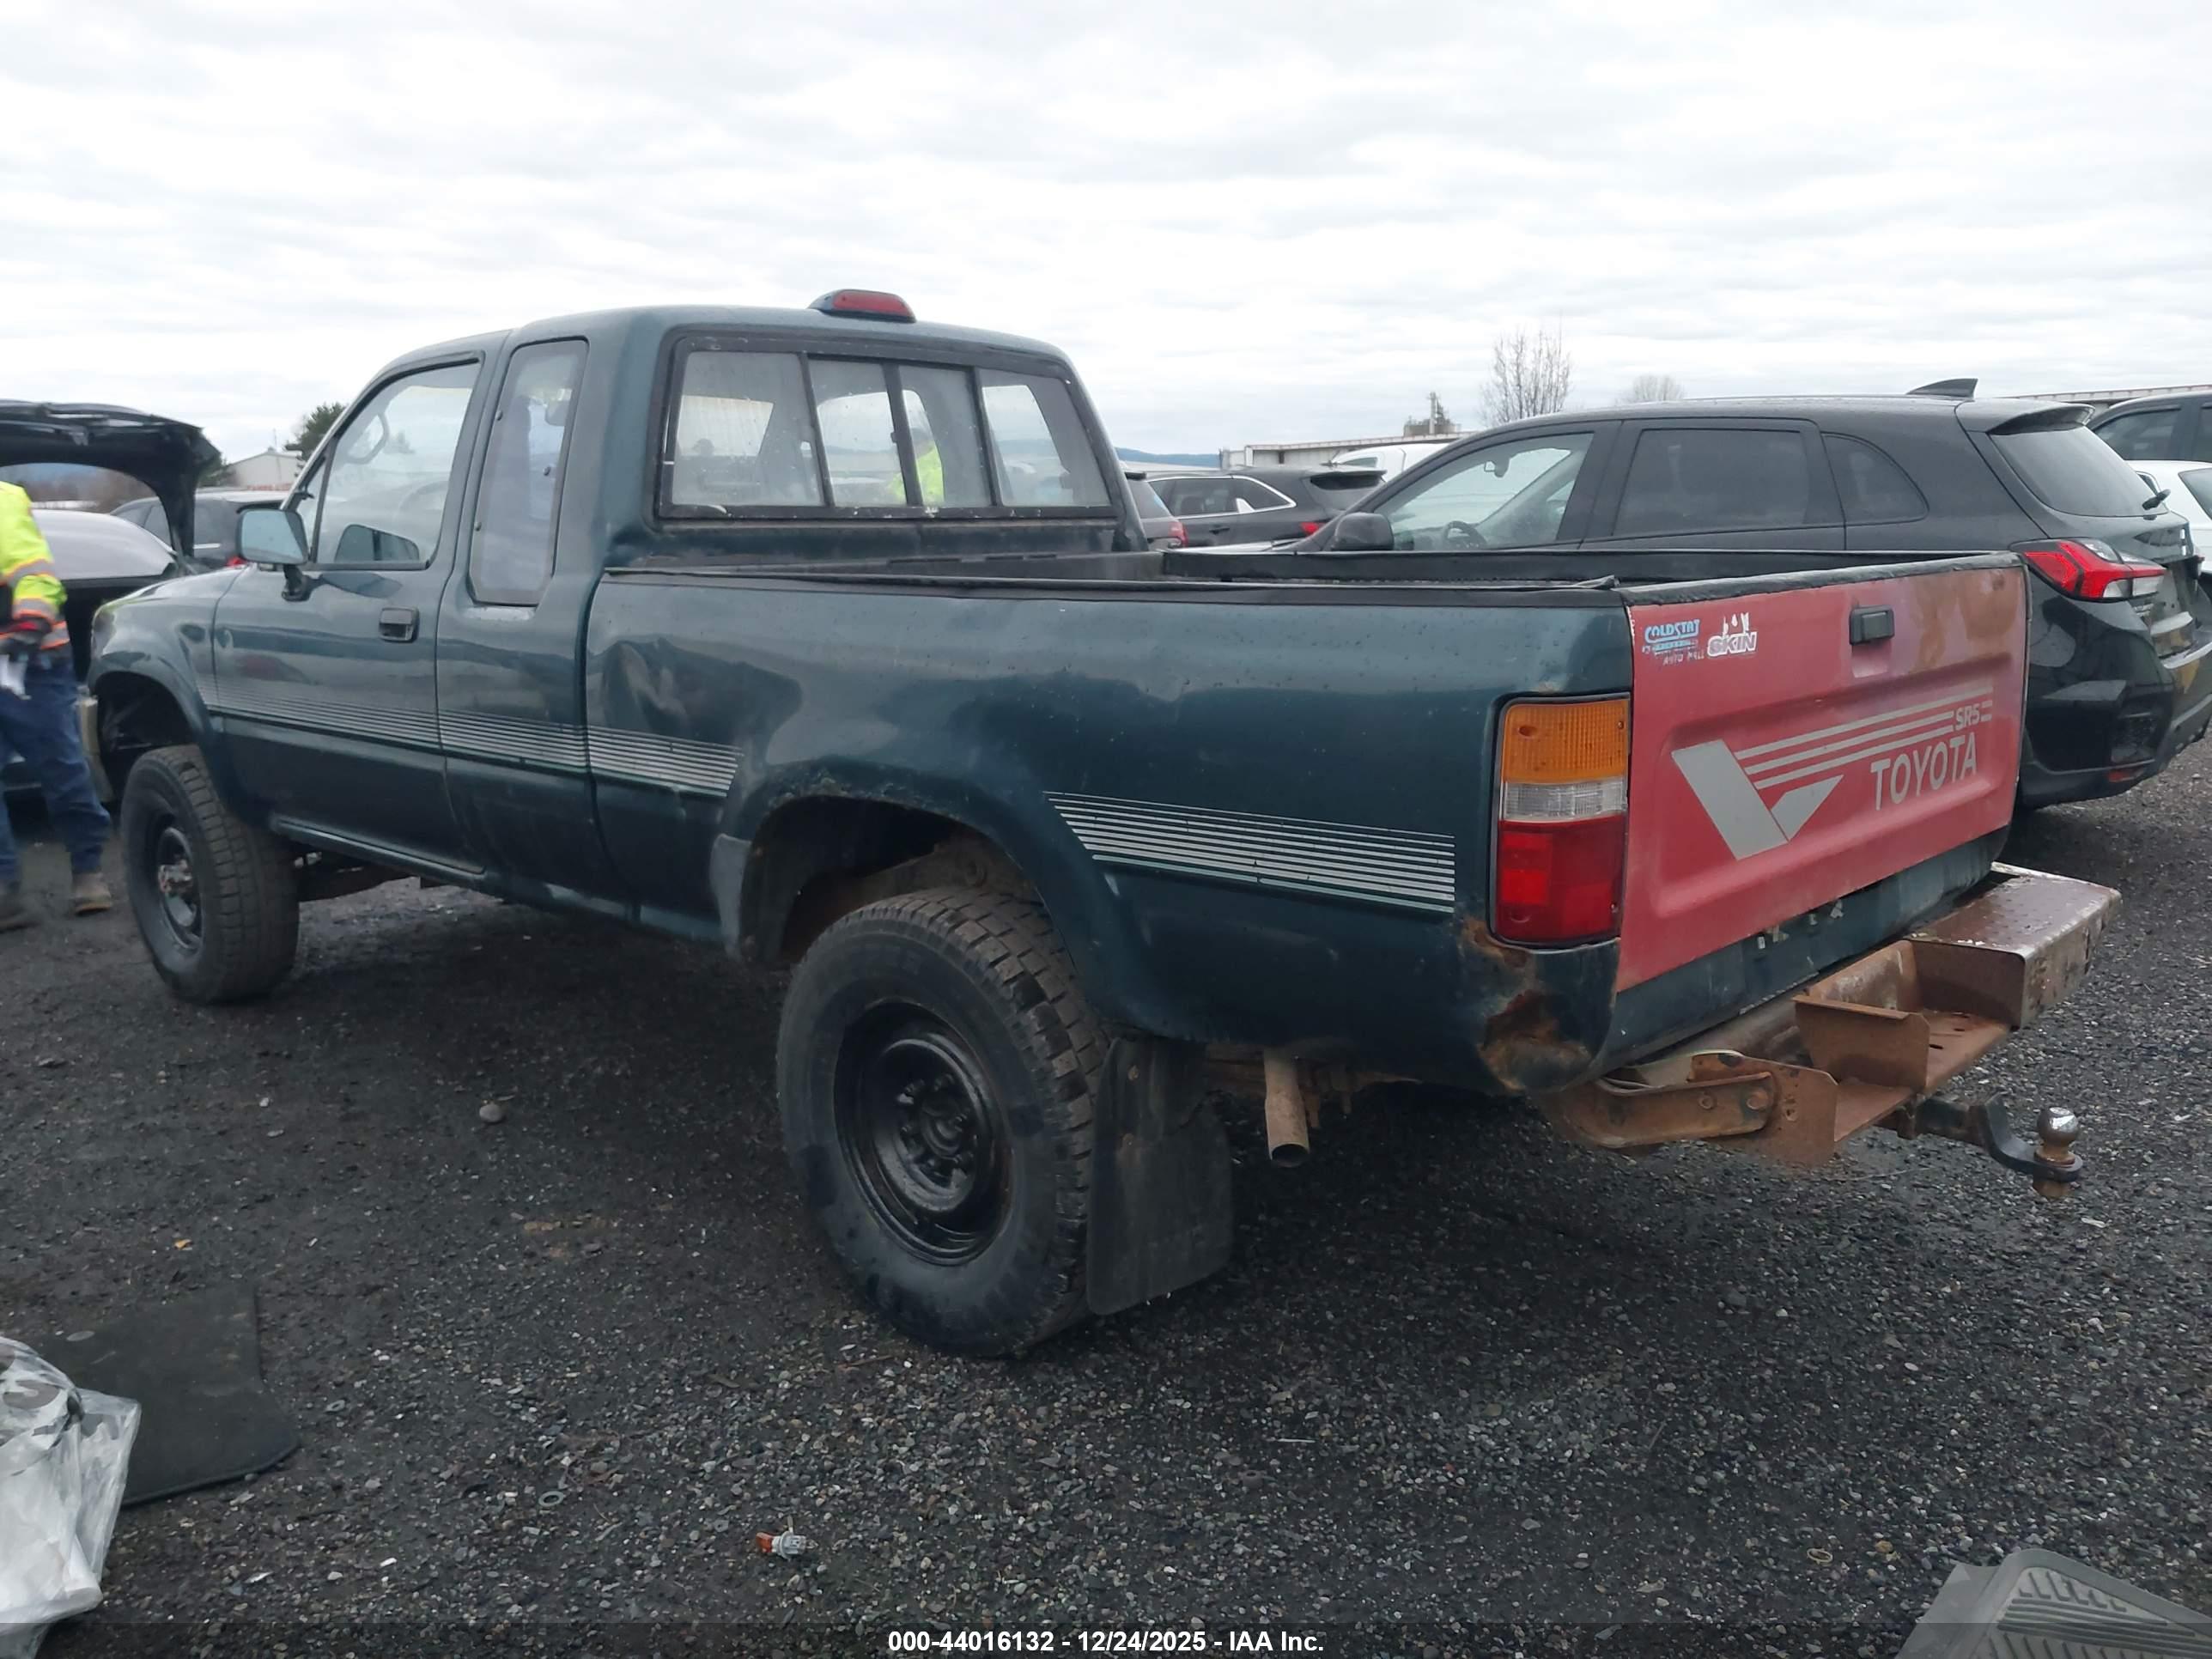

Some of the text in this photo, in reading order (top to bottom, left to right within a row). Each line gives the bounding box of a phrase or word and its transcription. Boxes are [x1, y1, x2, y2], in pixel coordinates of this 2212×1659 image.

[1707, 631, 1758, 658] SKIN
[1954, 703, 1980, 731] SR5
[1870, 732, 1977, 811] TOYOTA
